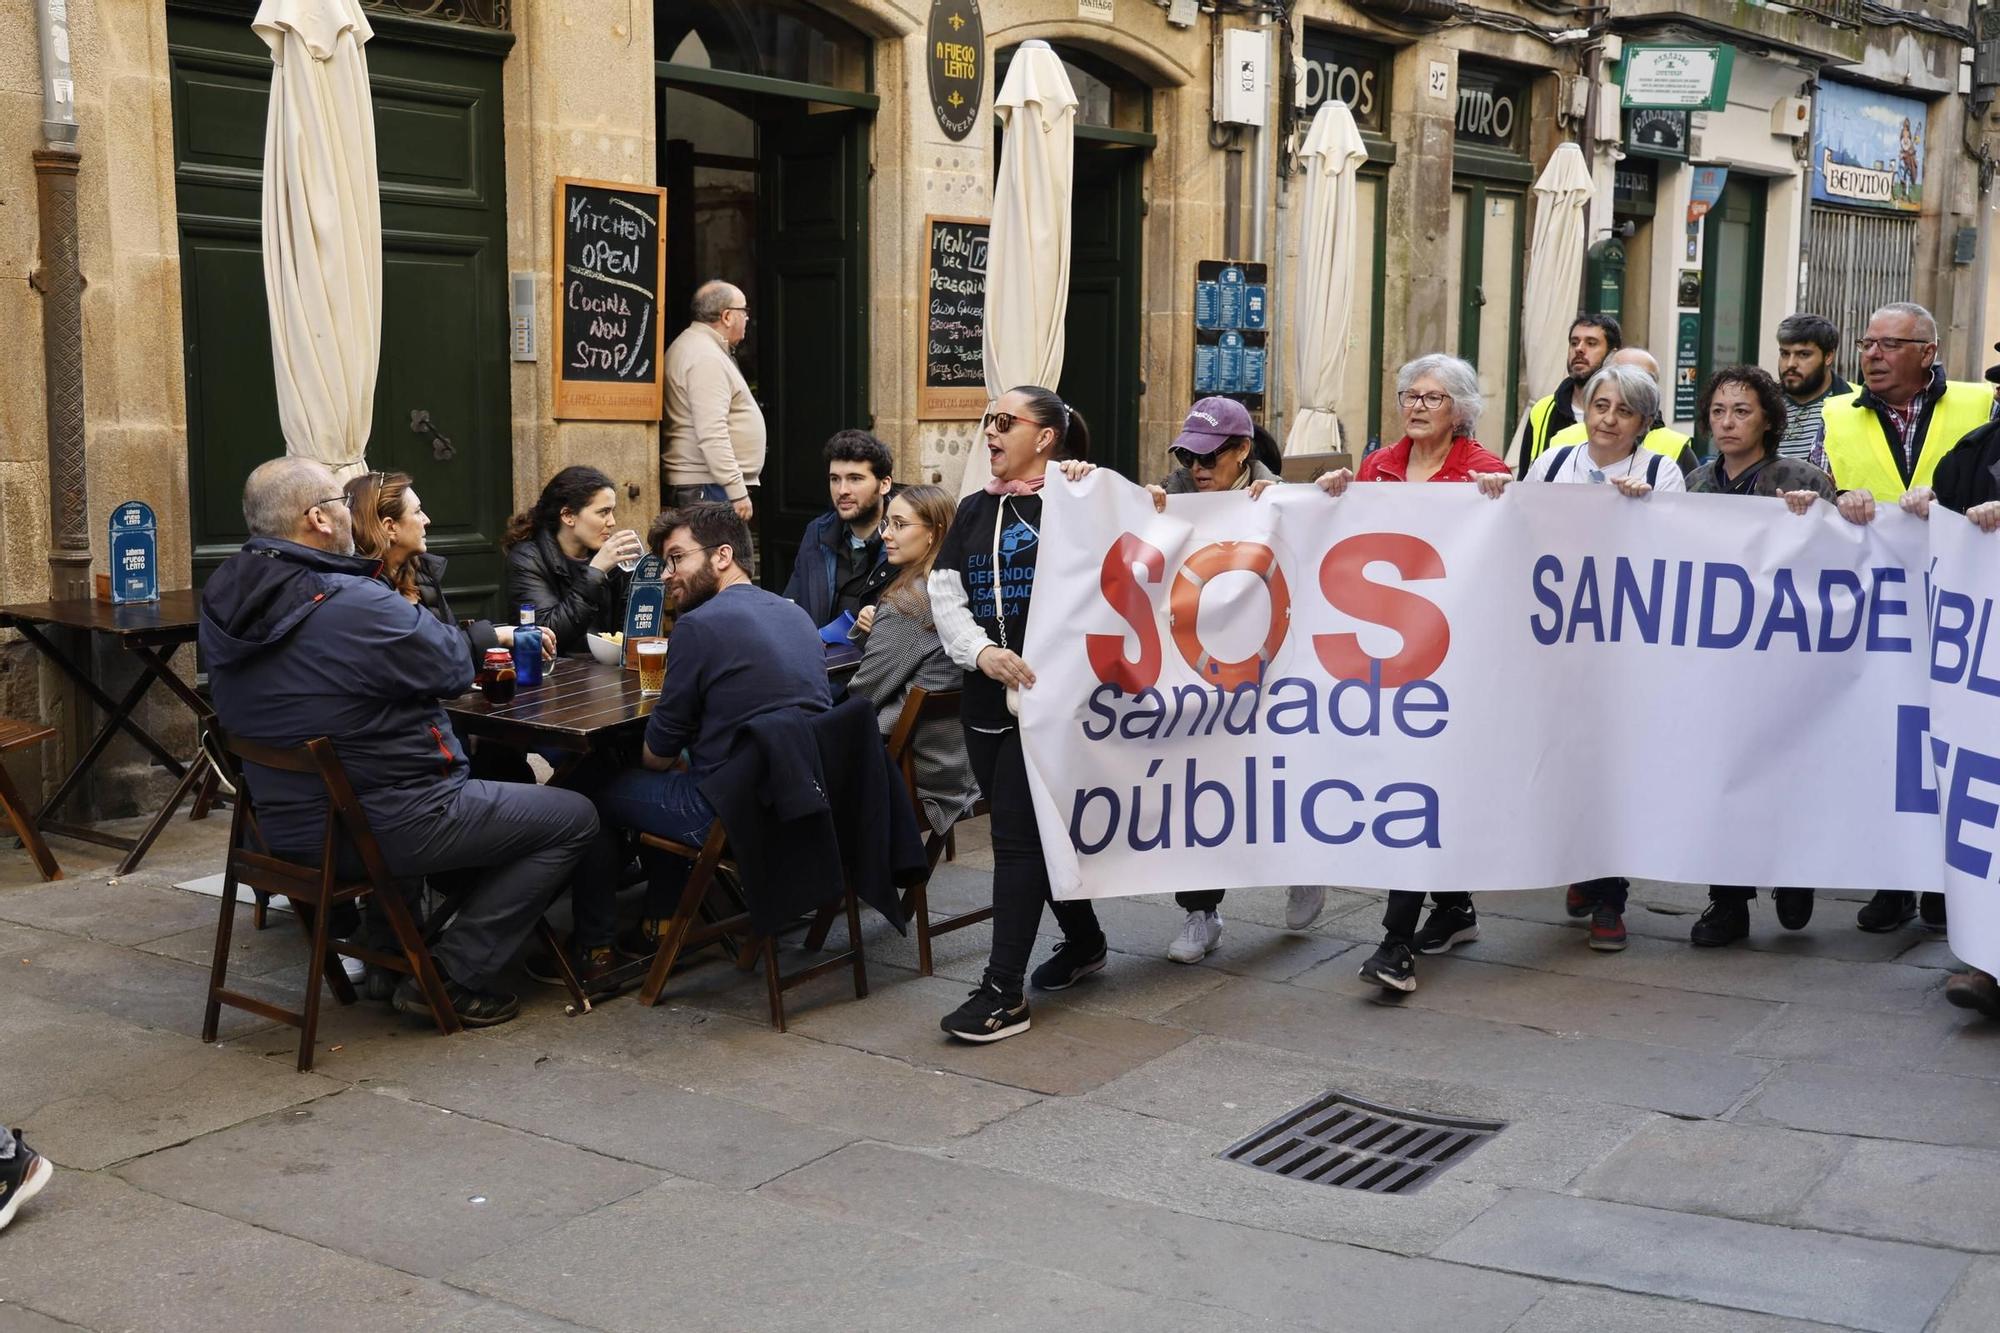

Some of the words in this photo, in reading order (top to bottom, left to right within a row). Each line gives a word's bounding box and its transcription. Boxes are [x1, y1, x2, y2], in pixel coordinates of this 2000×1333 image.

[936, 41, 943, 59] A
[945, 42, 975, 63] FUEGO
[945, 60, 975, 79] LENTO
[1432, 70, 1446, 91] 27
[937, 106, 976, 132] CERVEZAS
[1456, 88, 1513, 137] TURO
[1831, 169, 1890, 196] BENVIDO
[933, 228, 972, 256] MENÚ
[582, 240, 640, 275] OPEN
[942, 254, 962, 269] DEL
[590, 316, 627, 340] NON
[571, 340, 628, 370] STOP
[968, 554, 986, 568] EU
[1085, 532, 1450, 694] SOS
[1530, 554, 1912, 653] SANIDADE
[1081, 659, 1449, 741] sanidade
[1069, 756, 1441, 855] pública
